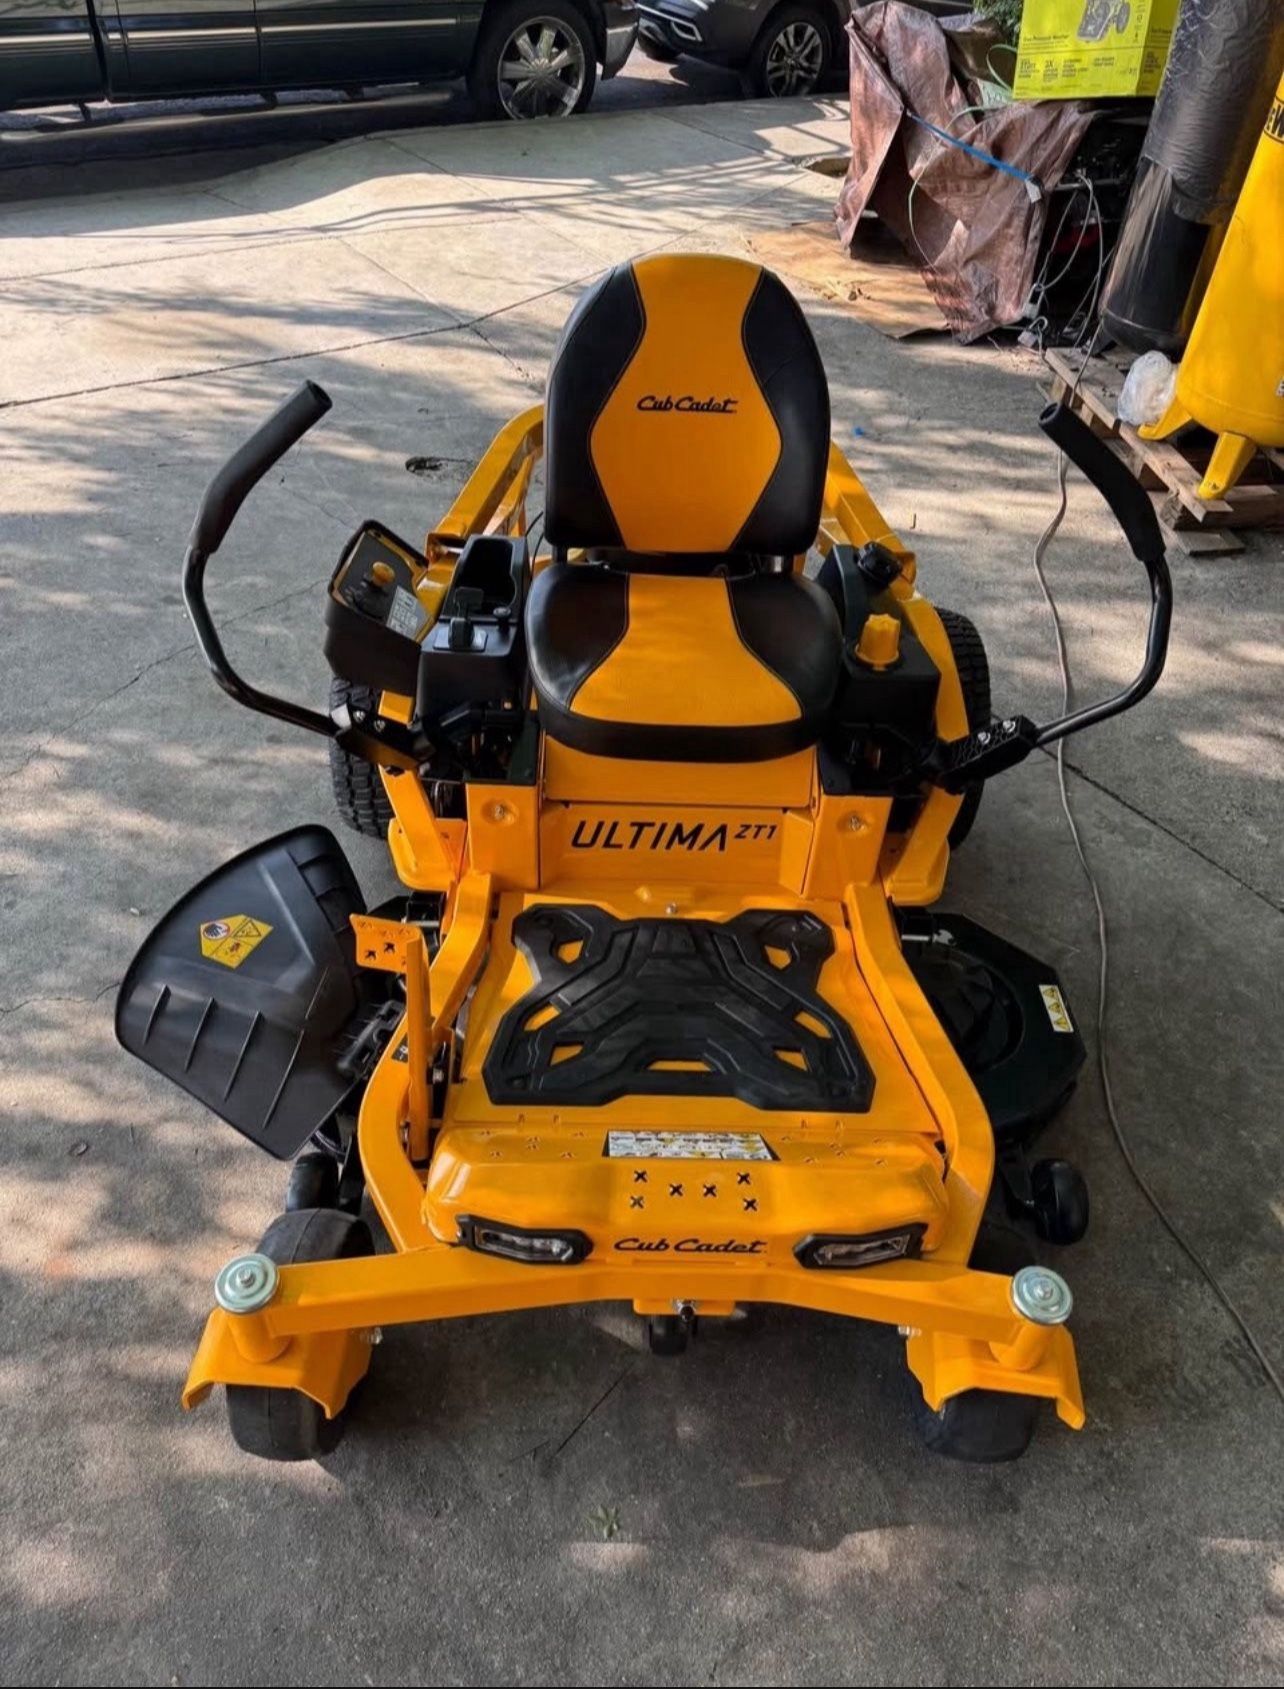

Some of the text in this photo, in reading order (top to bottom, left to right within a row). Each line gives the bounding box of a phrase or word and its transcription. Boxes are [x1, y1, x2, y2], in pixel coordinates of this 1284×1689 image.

[637, 395, 738, 414] Cub Cadet
[571, 820, 777, 851] ULTIMA ZT1
[614, 1238, 767, 1254] Cub Cadet
